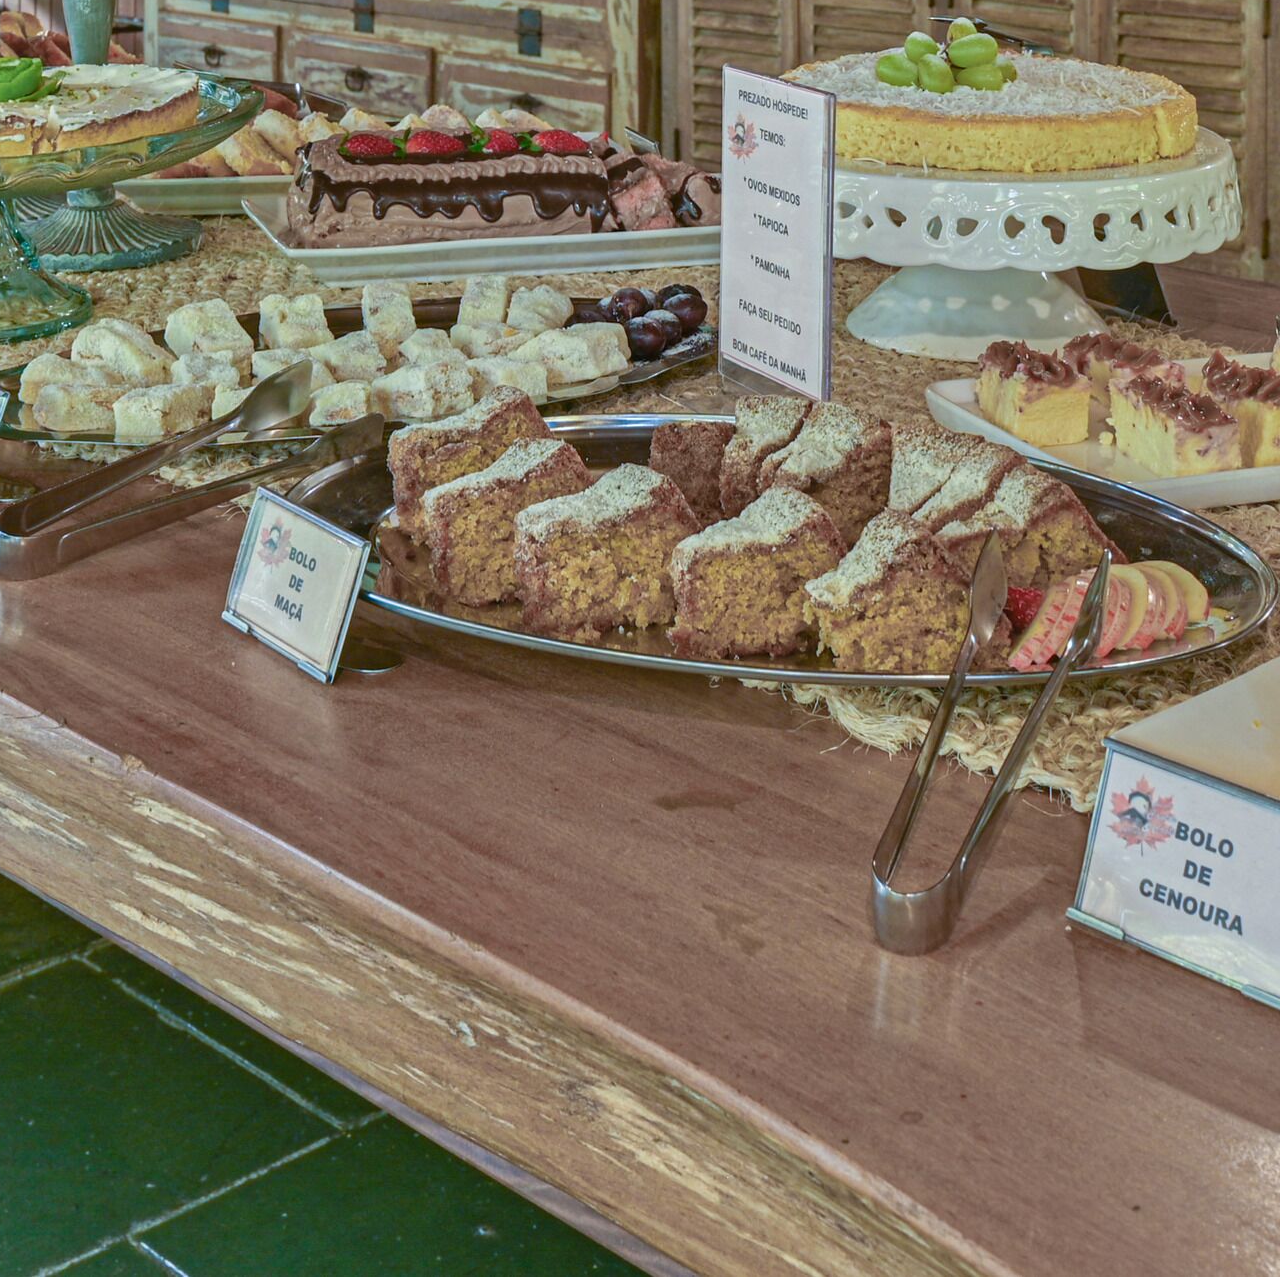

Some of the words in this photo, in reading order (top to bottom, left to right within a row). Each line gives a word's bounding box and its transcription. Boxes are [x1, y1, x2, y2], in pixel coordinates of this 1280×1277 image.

[738, 89, 771, 109] PREZADO
[772, 98, 808, 120] HÓSPEDE!
[759, 128, 786, 147] TEMOS:
[747, 178, 768, 195] OVOS
[769, 185, 801, 206] MEXIDOS
[757, 215, 789, 237] TAPIOCA
[754, 256, 791, 280] PAMONHA
[738, 299, 757, 316] FAÇA
[758, 307, 773, 323] SEU
[774, 314, 802, 336] PEDIDO
[732, 338, 748, 355] BOM
[749, 345, 768, 365] CAFÉ
[768, 355, 779, 370] DA
[779, 361, 807, 383] MANHÃ
[288, 546, 317, 572] BOLO
[288, 573, 304, 593] DE
[274, 593, 304, 622] MAÇÃ
[1174, 821, 1234, 858] BOLO
[1182, 859, 1213, 886] DE
[1138, 878, 1244, 936] CENOURA
